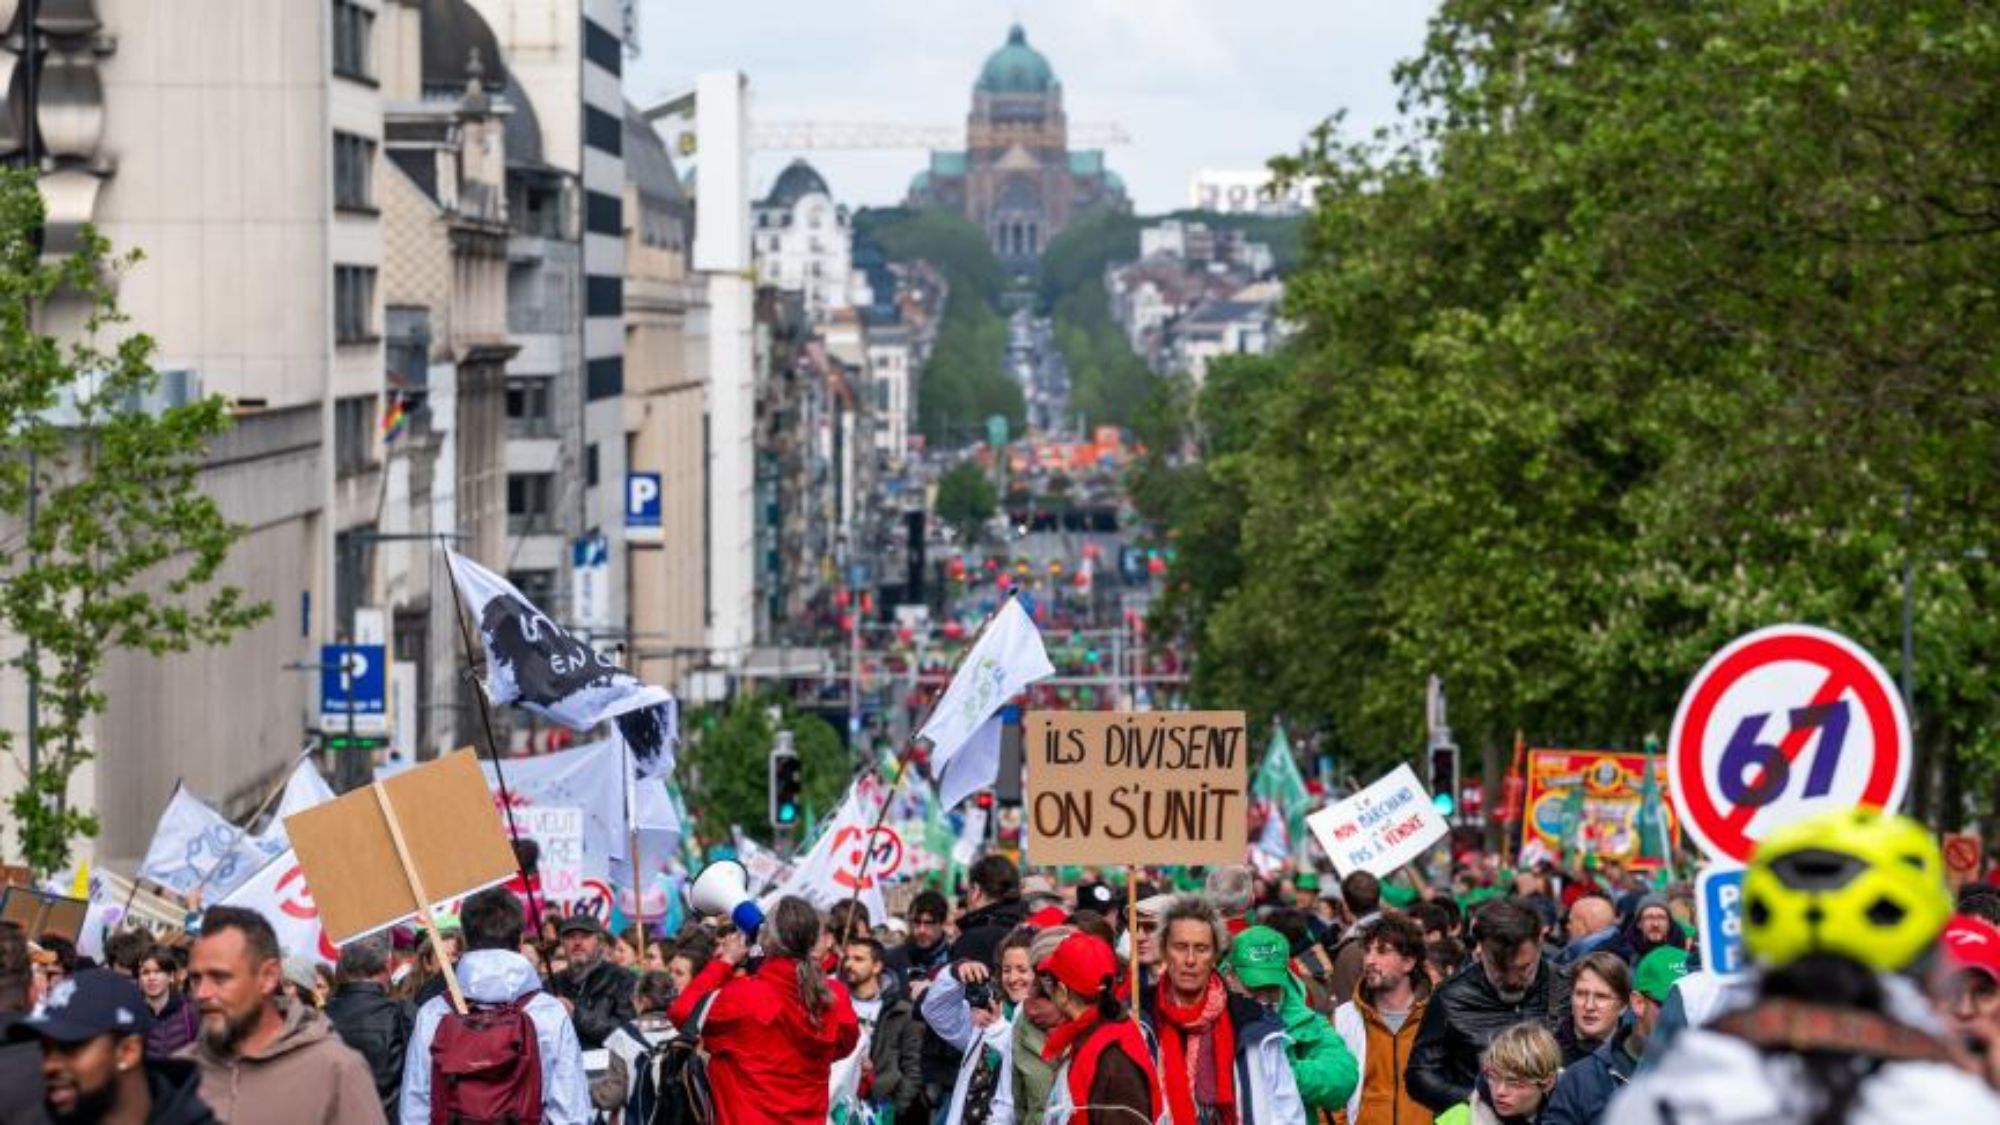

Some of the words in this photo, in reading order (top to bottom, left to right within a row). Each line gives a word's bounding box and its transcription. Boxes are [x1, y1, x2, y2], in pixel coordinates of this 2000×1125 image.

[630, 476, 657, 515] P
[340, 652, 368, 691] P
[1717, 699, 1850, 808] 67
[1034, 789, 1092, 839] ON
